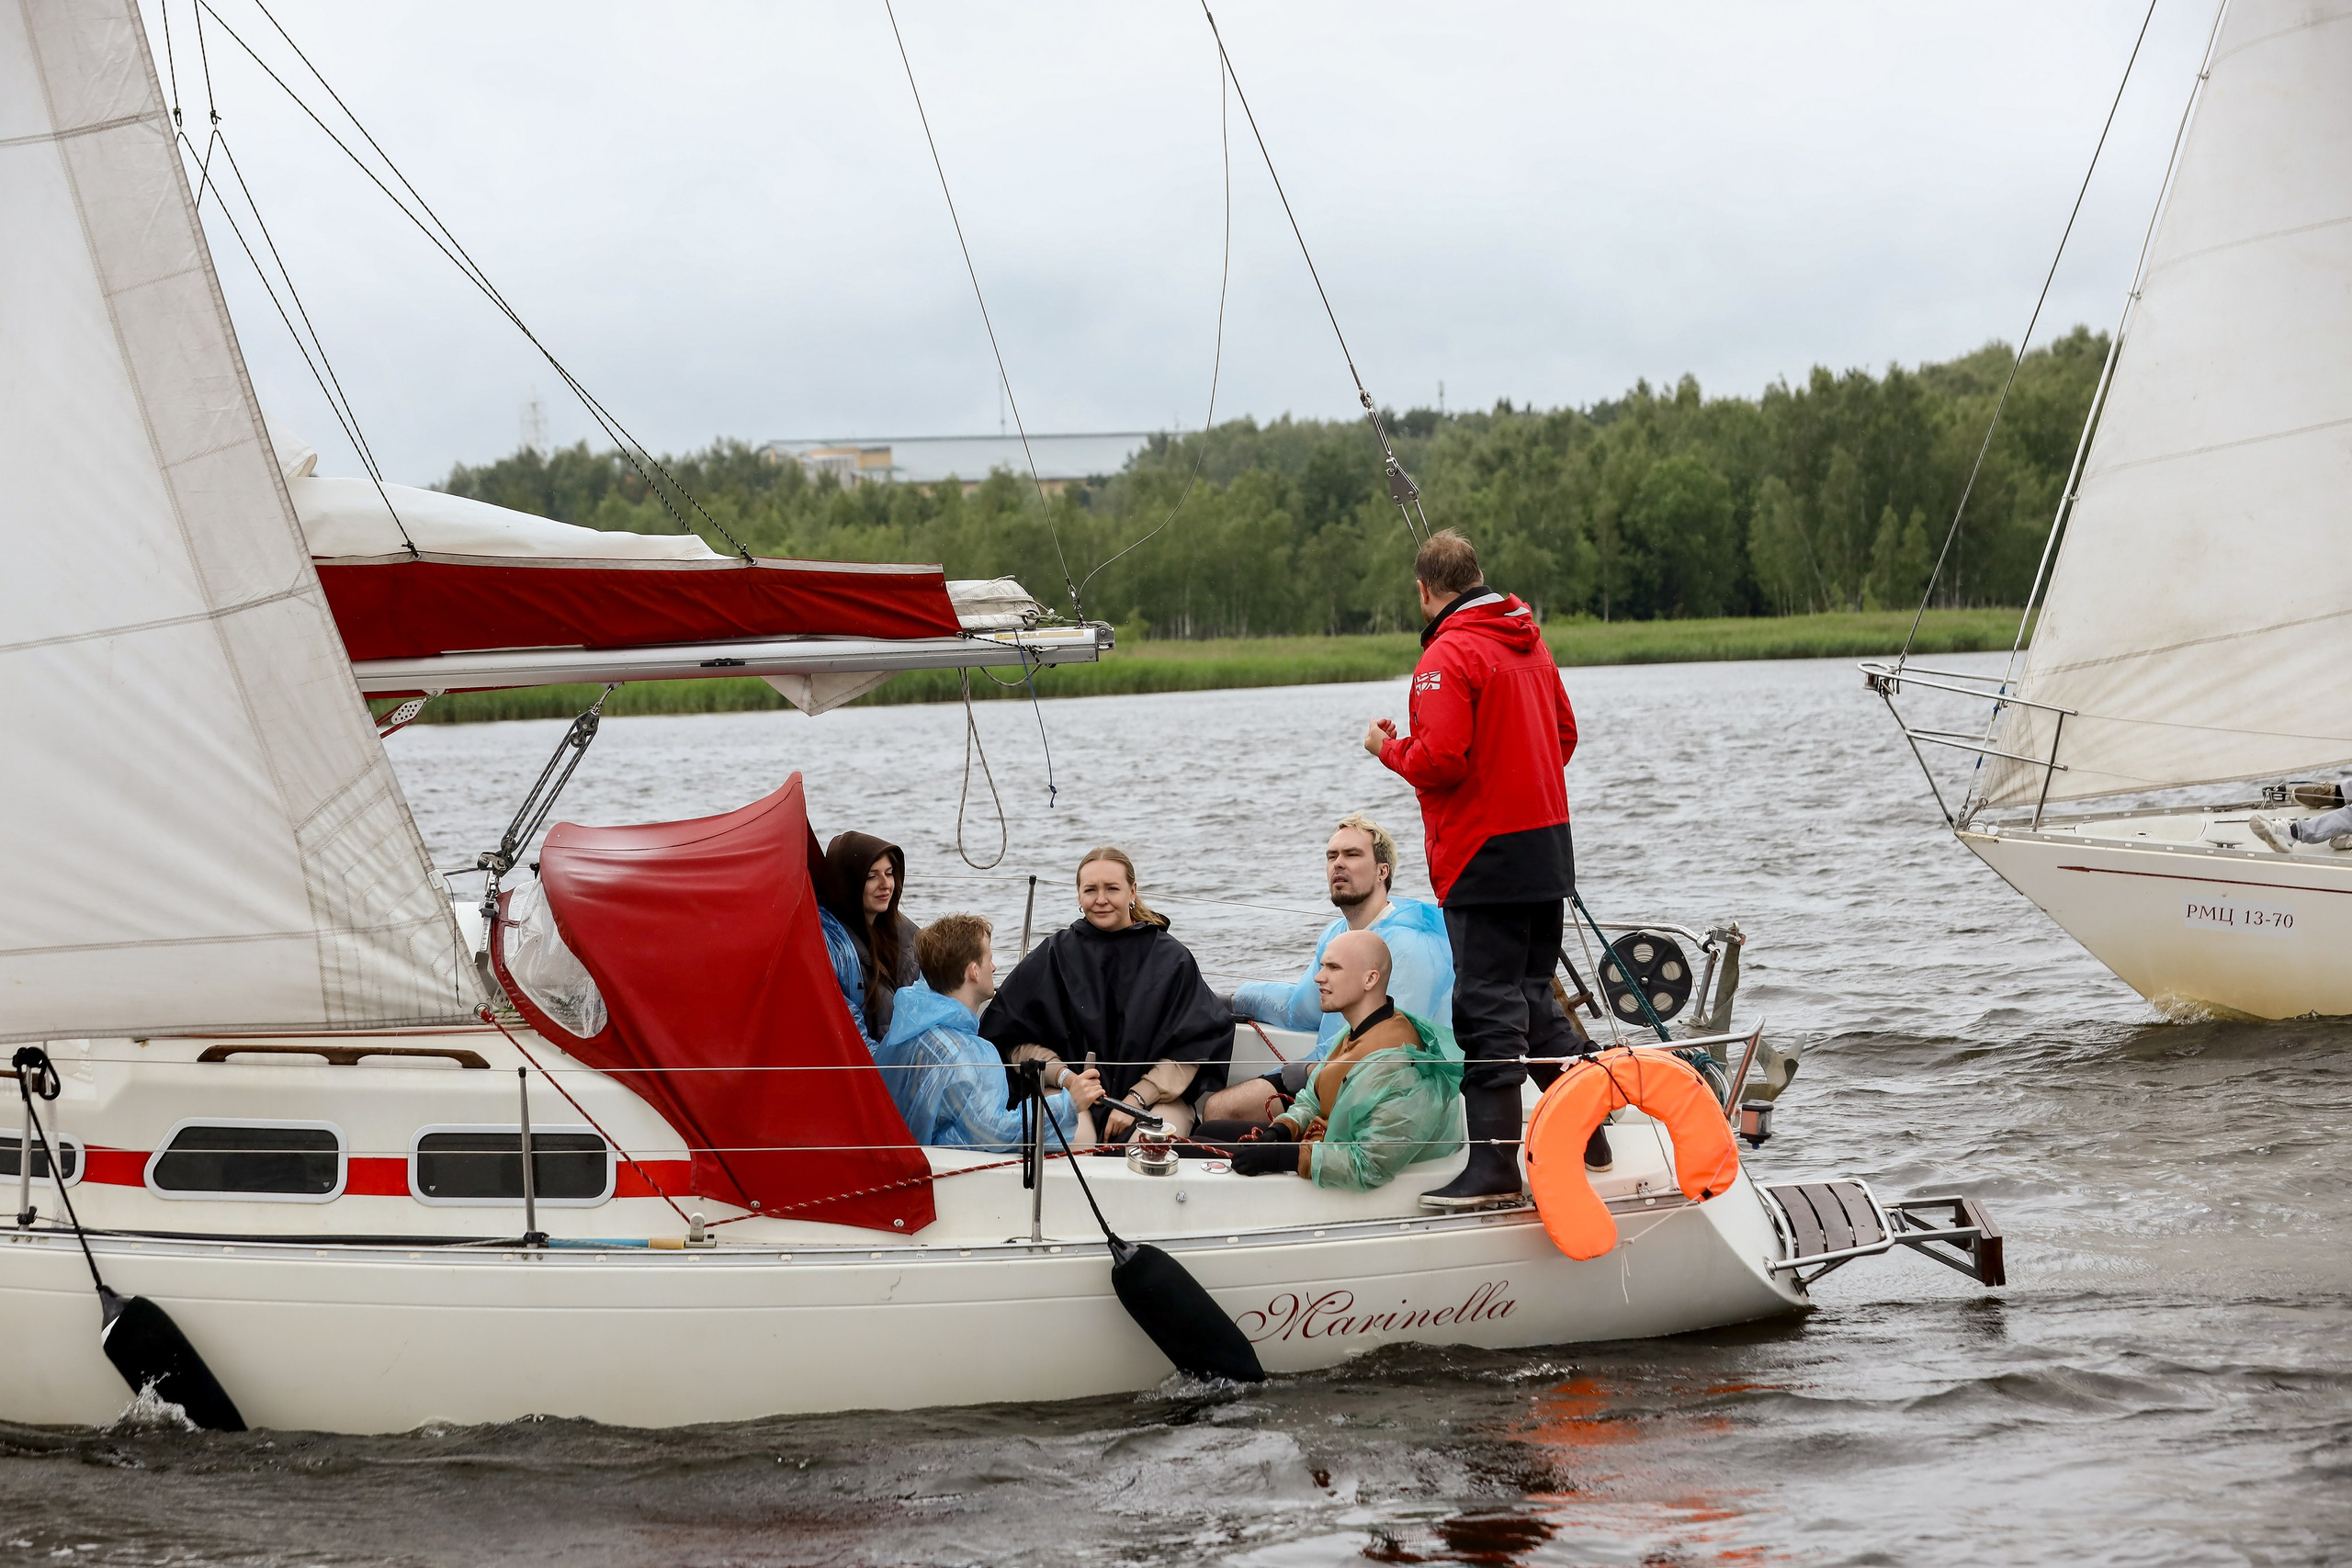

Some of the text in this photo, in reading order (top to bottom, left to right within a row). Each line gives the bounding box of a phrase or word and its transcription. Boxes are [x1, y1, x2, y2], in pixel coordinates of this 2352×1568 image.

[2187, 904, 2294, 929] РМЦ 13-70
[1235, 1280, 1518, 1342] Marinella
